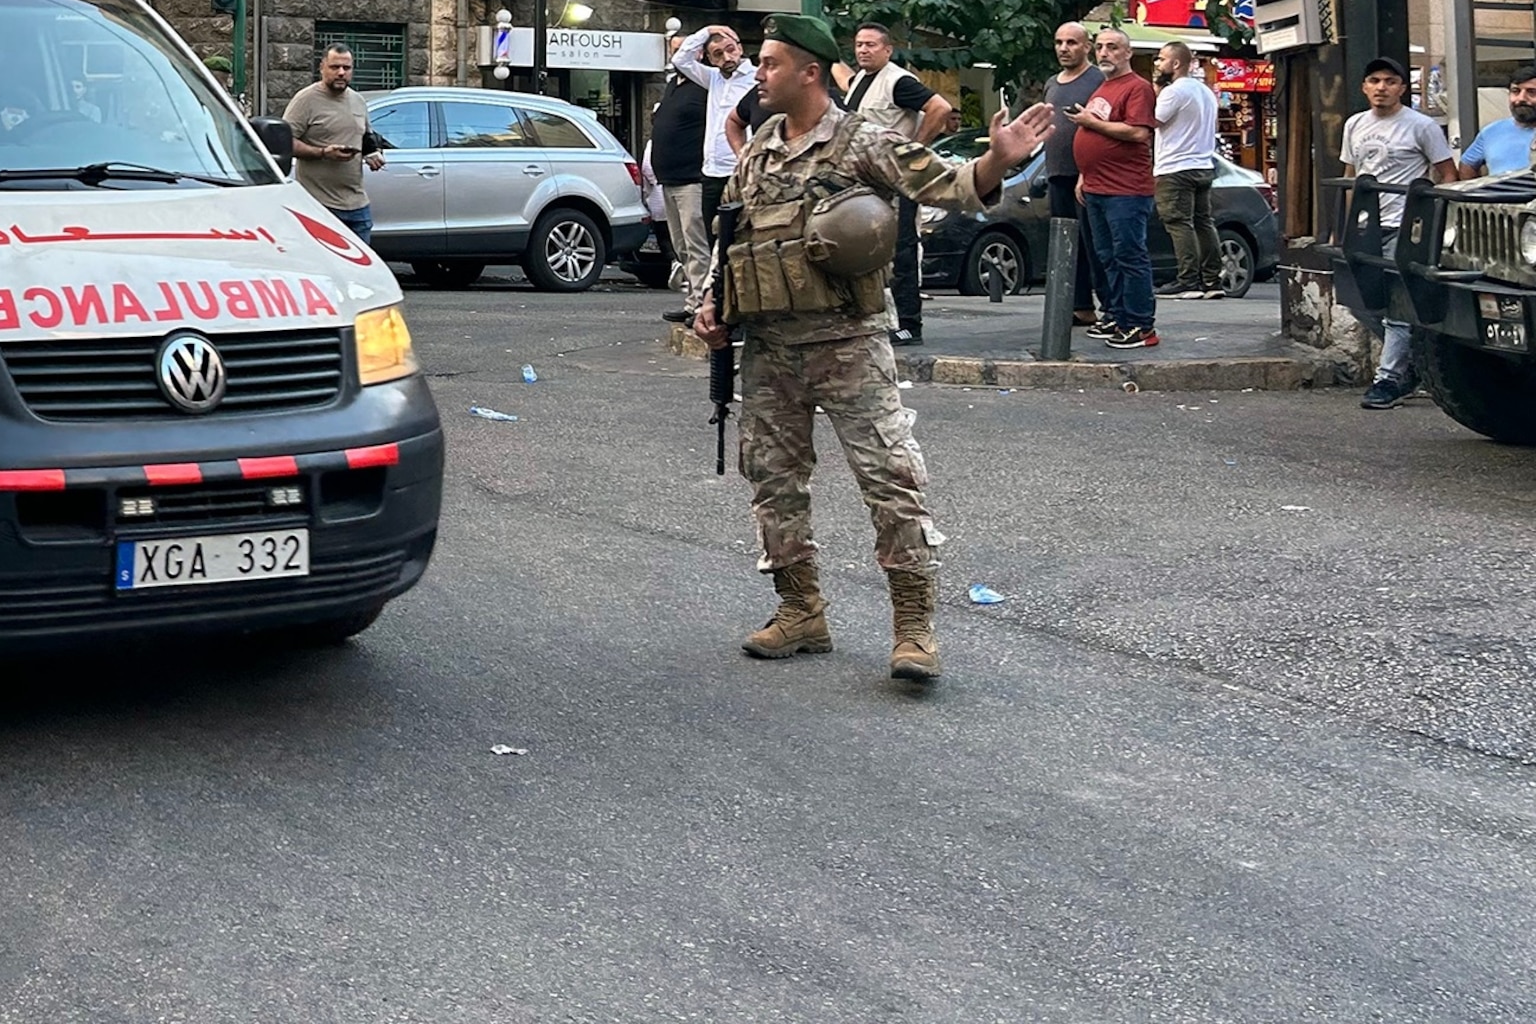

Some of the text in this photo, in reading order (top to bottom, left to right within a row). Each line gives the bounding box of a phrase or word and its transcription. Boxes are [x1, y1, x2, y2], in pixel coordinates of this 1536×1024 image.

[561, 50, 599, 59] salon
[140, 535, 301, 582] XGA 332
